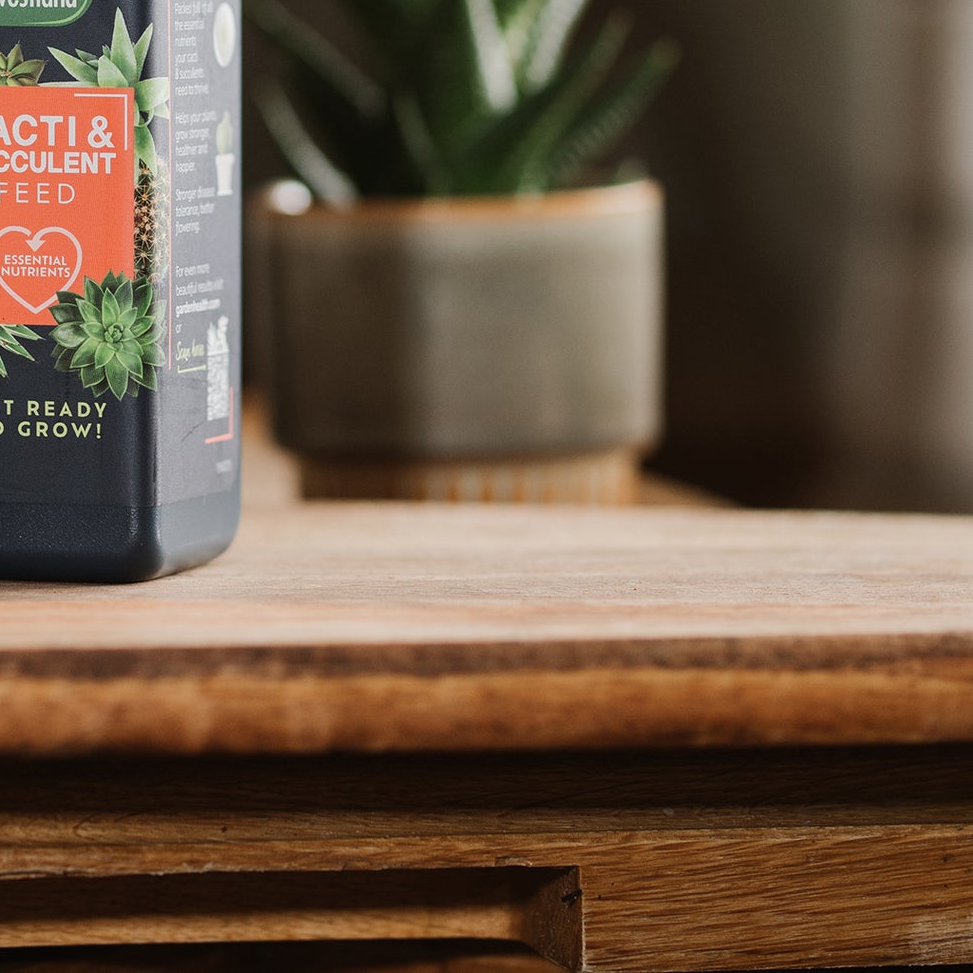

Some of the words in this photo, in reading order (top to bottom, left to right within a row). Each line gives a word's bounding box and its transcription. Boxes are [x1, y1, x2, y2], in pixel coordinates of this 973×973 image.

[87, 115, 115, 148] &
[4, 254, 67, 266] ESSENTIAL
[1, 266, 70, 278] NUTRIENTS
[27, 400, 107, 418] READY
[17, 421, 102, 439] GROW!
